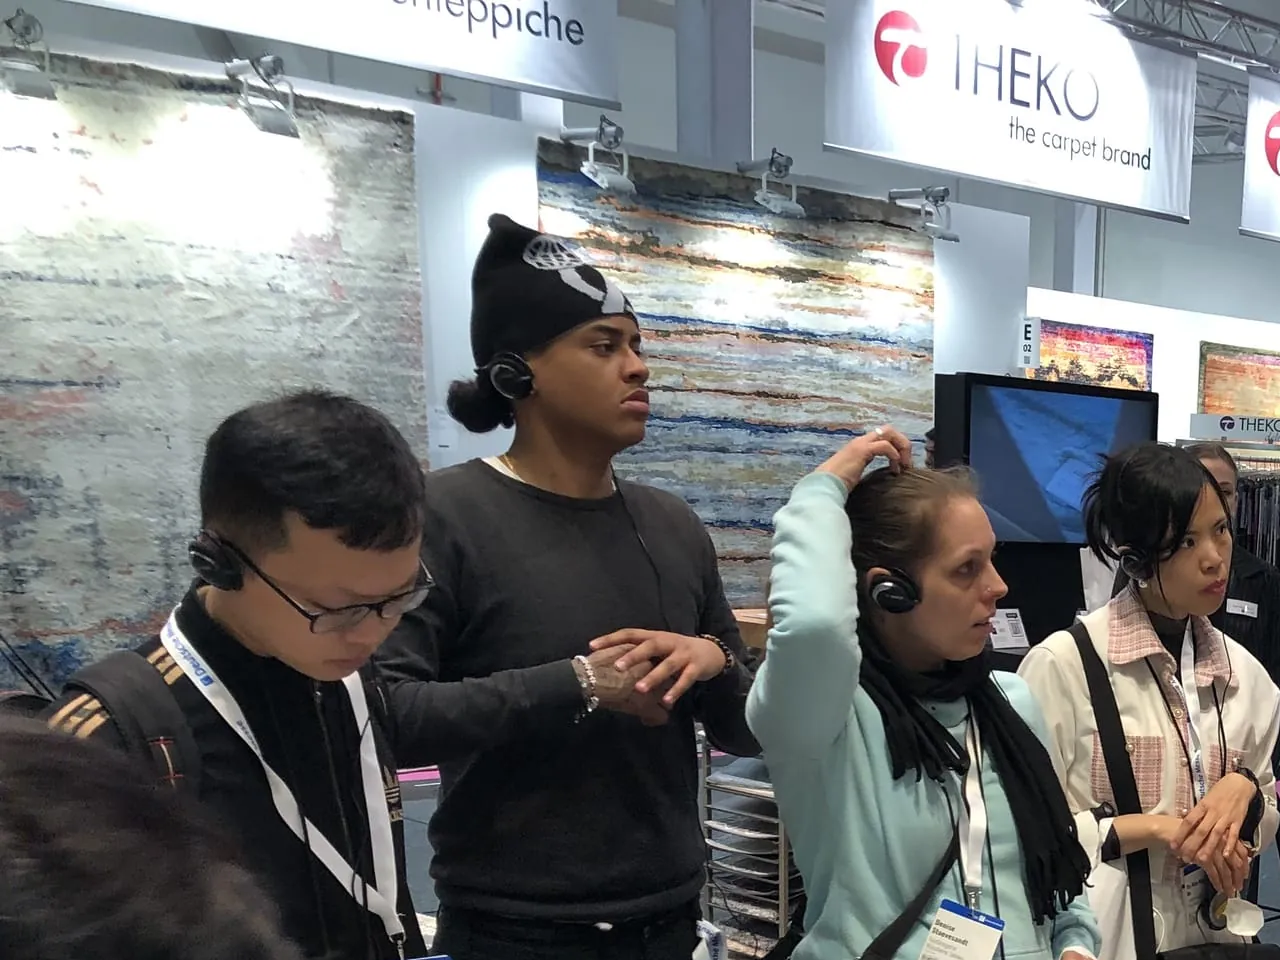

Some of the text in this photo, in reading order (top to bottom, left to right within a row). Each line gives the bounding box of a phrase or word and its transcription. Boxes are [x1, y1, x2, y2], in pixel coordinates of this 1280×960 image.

[953, 33, 1100, 121] THEKO
[1009, 116, 1151, 170] the carpet brand
[1023, 343, 1032, 353] 02
[1024, 323, 1032, 341] E
